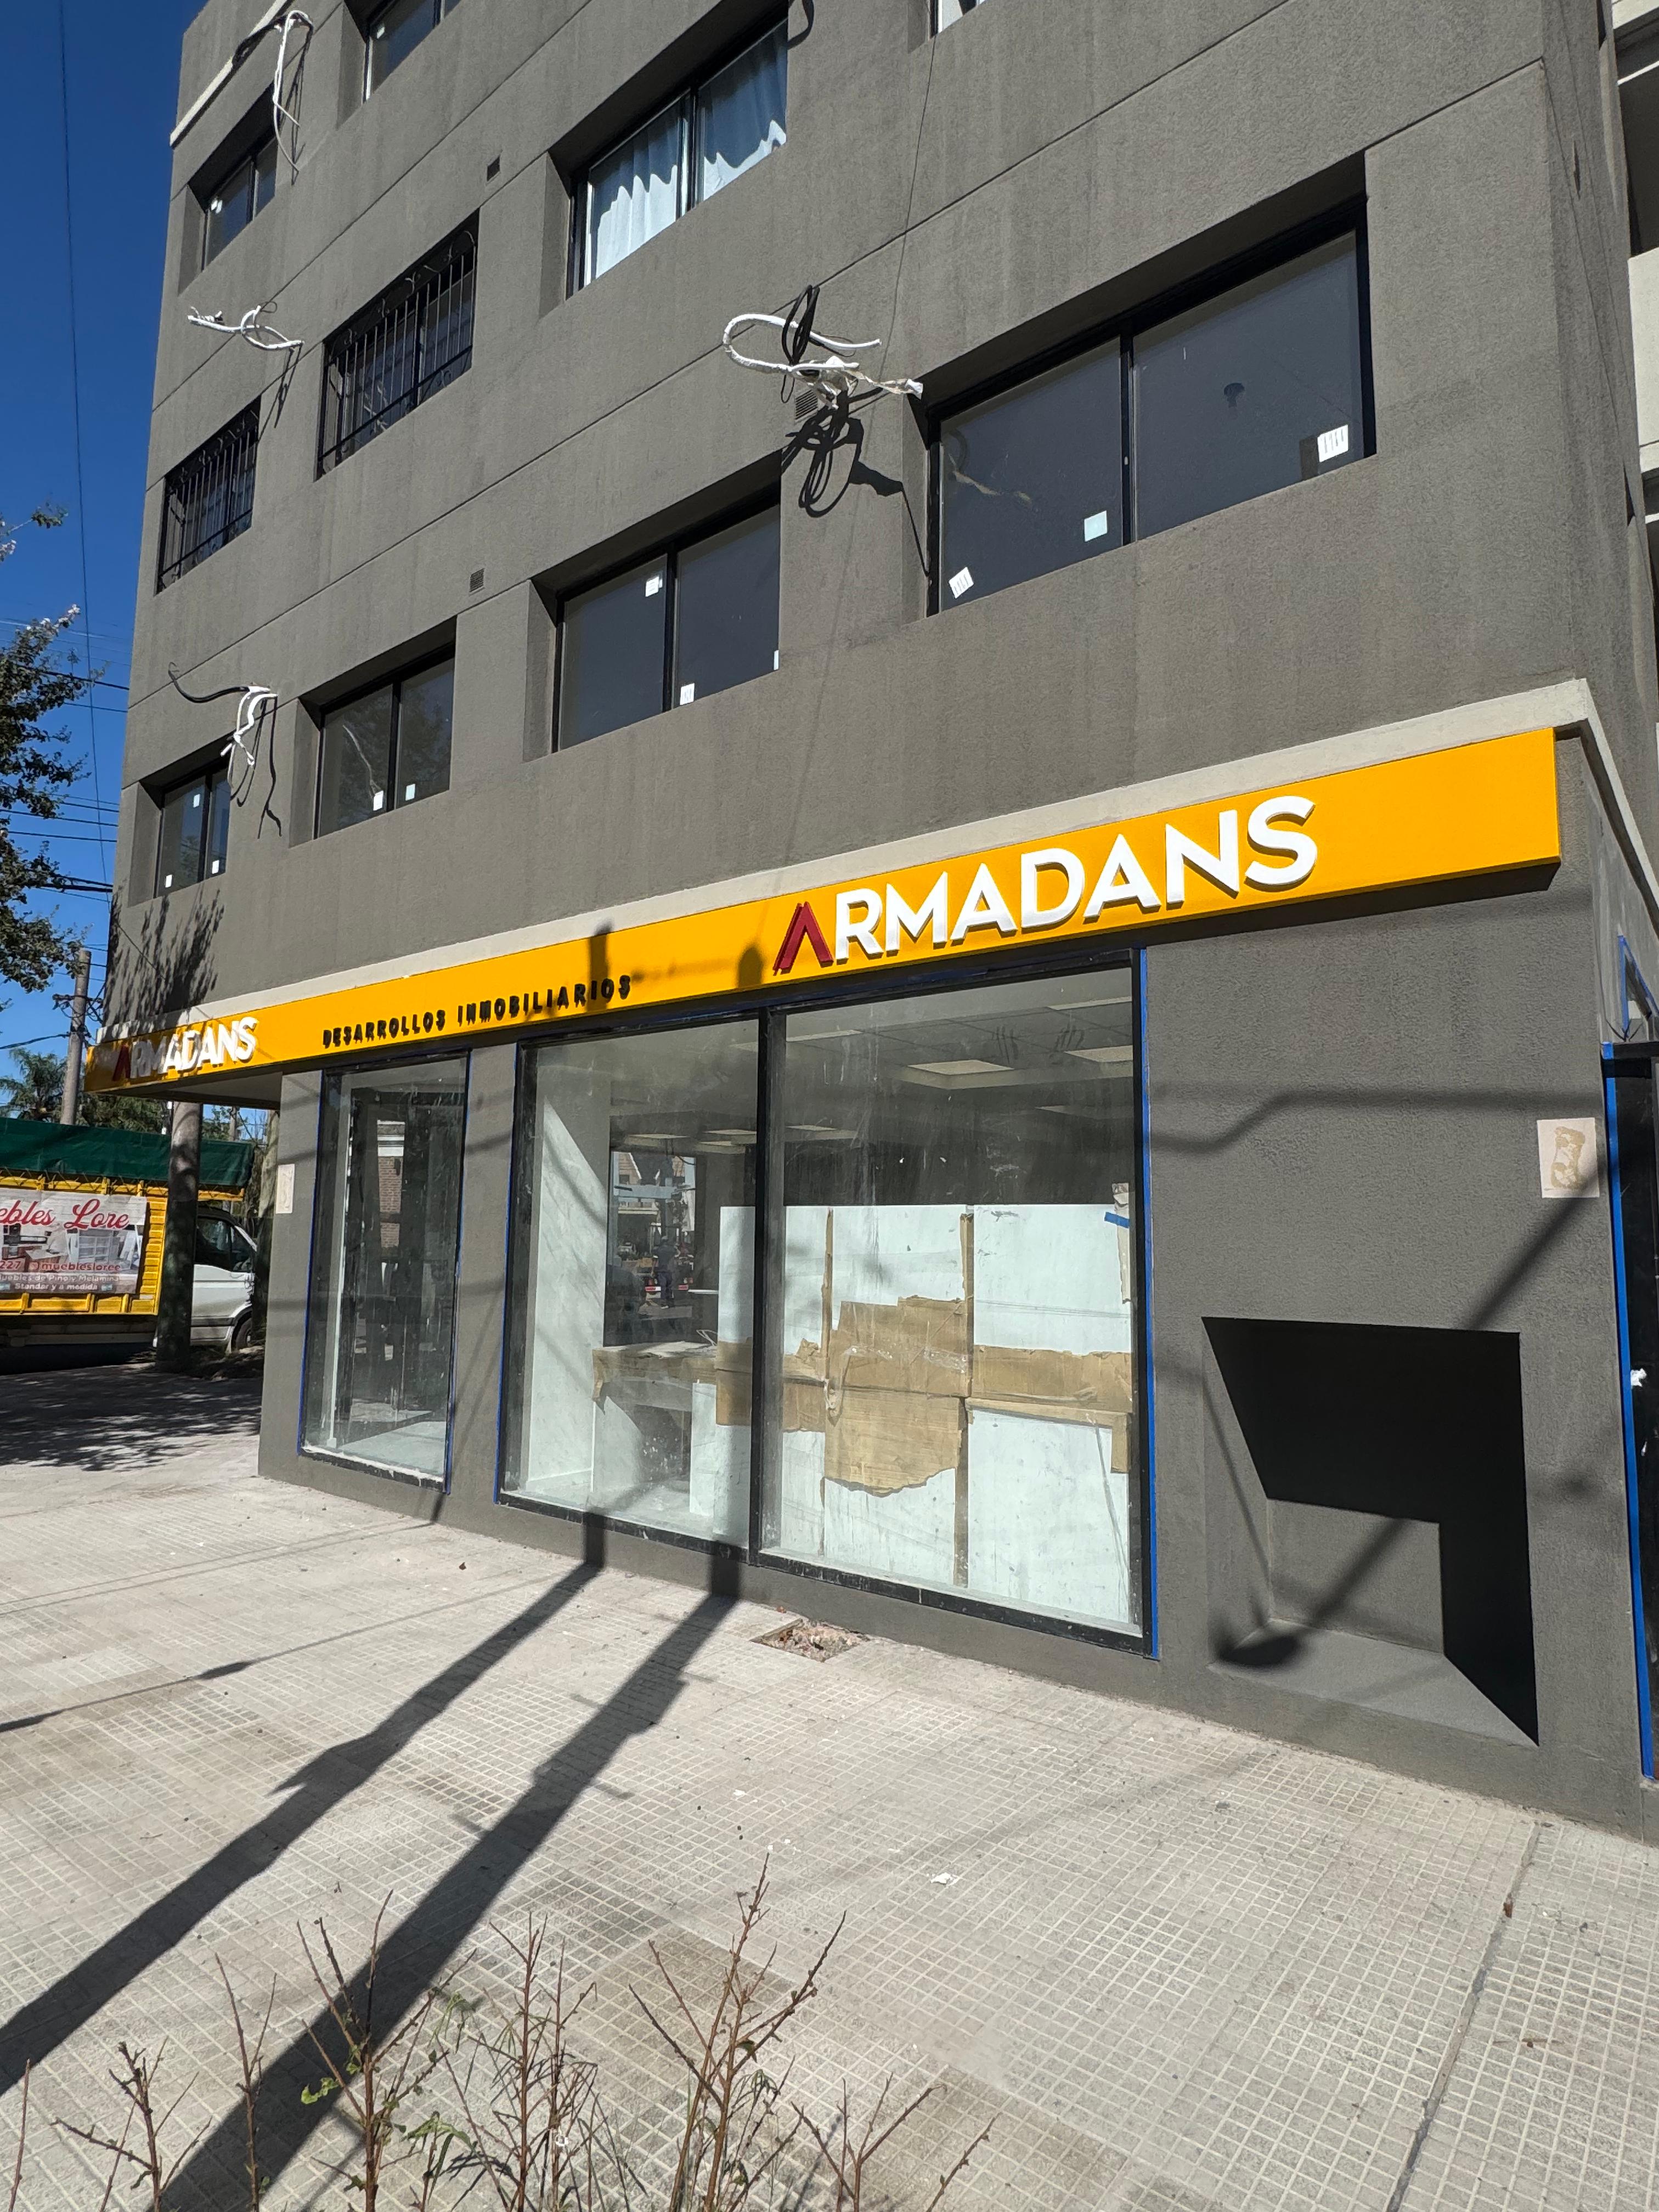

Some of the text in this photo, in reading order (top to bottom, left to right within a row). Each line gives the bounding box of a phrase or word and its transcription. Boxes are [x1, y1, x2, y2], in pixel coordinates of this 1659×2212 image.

[772, 795, 1318, 975] ARMADANS
[323, 975, 631, 1048] DESARROLLOS INMOBILIARIOS
